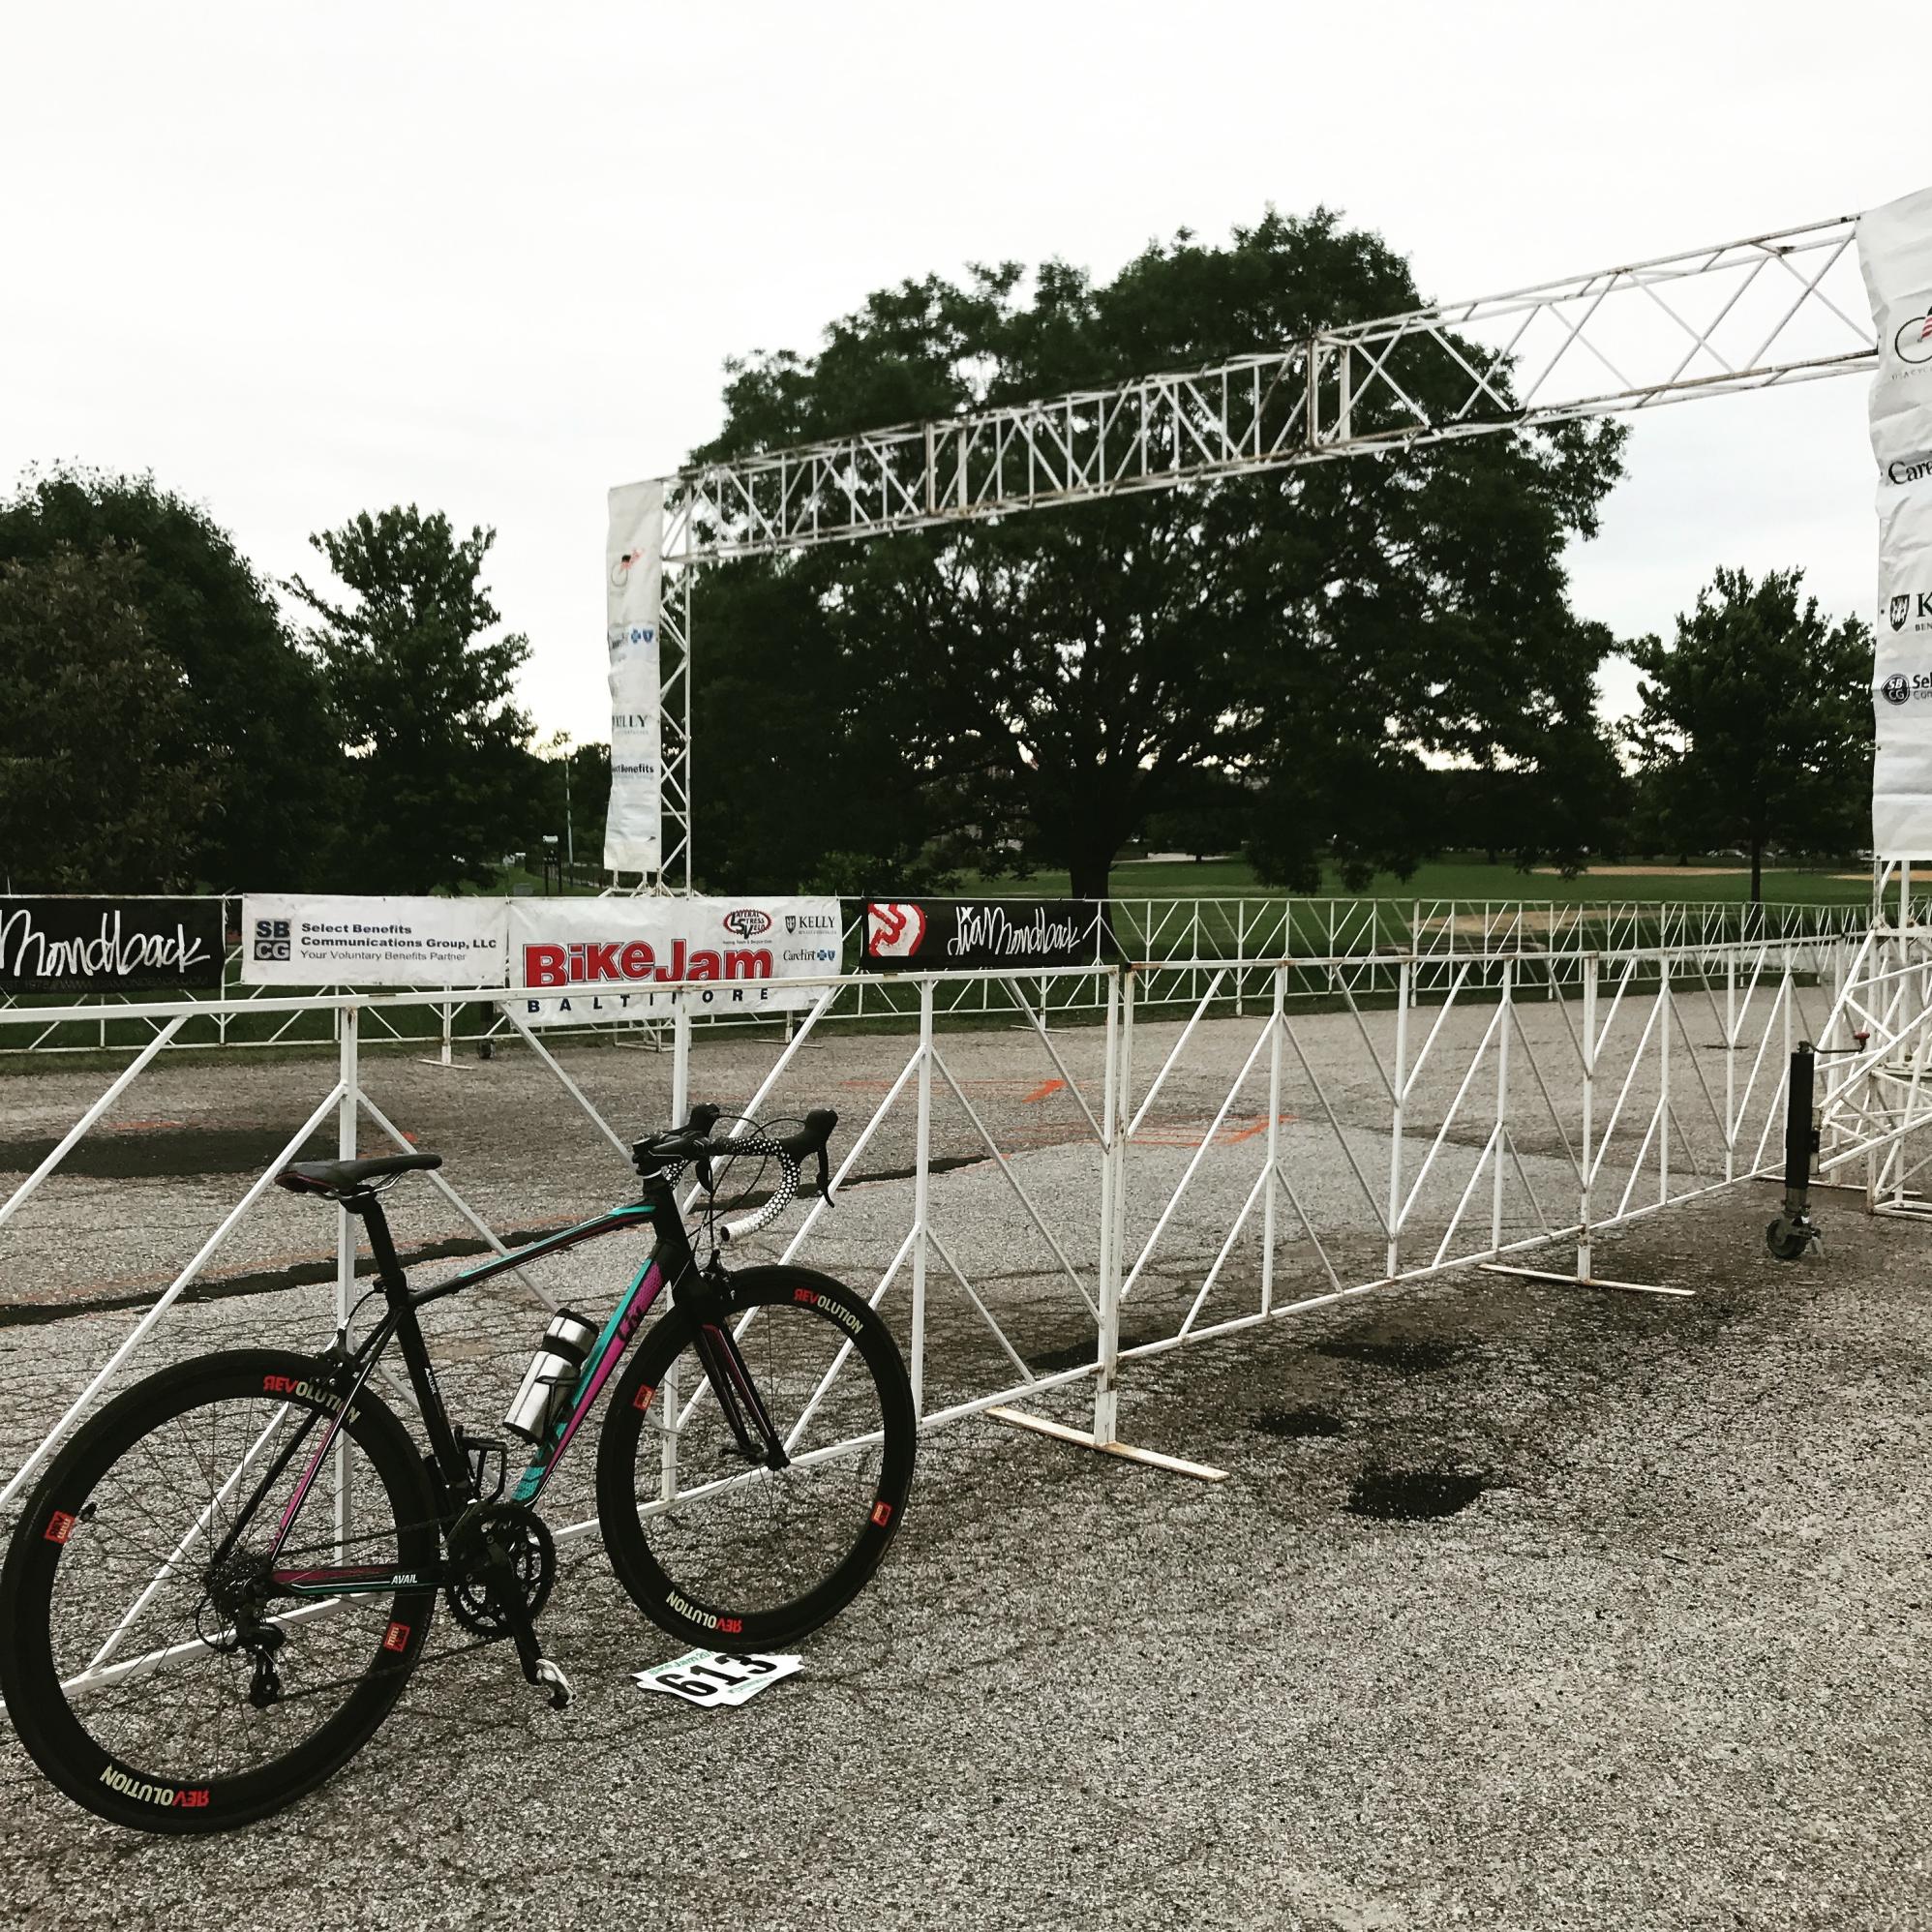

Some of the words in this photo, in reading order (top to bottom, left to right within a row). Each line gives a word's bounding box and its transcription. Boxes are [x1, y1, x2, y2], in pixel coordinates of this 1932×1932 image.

[256, 921, 289, 938] SB
[301, 922, 348, 934] Select
[352, 923, 412, 935] Benefits
[800, 916, 835, 928] KELLY
[256, 942, 289, 959] CG
[301, 936, 423, 948] Communications
[426, 938, 469, 950] Group,
[472, 939, 497, 949] LLC
[300, 950, 326, 960] Your
[331, 951, 381, 961] Voluntary
[385, 951, 427, 961] Benefits
[430, 952, 467, 961] Partner
[528, 987, 769, 1013] BALTIORE
[794, 1288, 864, 1335] REVOLUTION
[390, 1574, 418, 1585] AVAIL
[666, 1588, 743, 1634] REVOLUTION
[655, 1653, 777, 1697] 613
[99, 1762, 210, 1807] REVOLUTION
